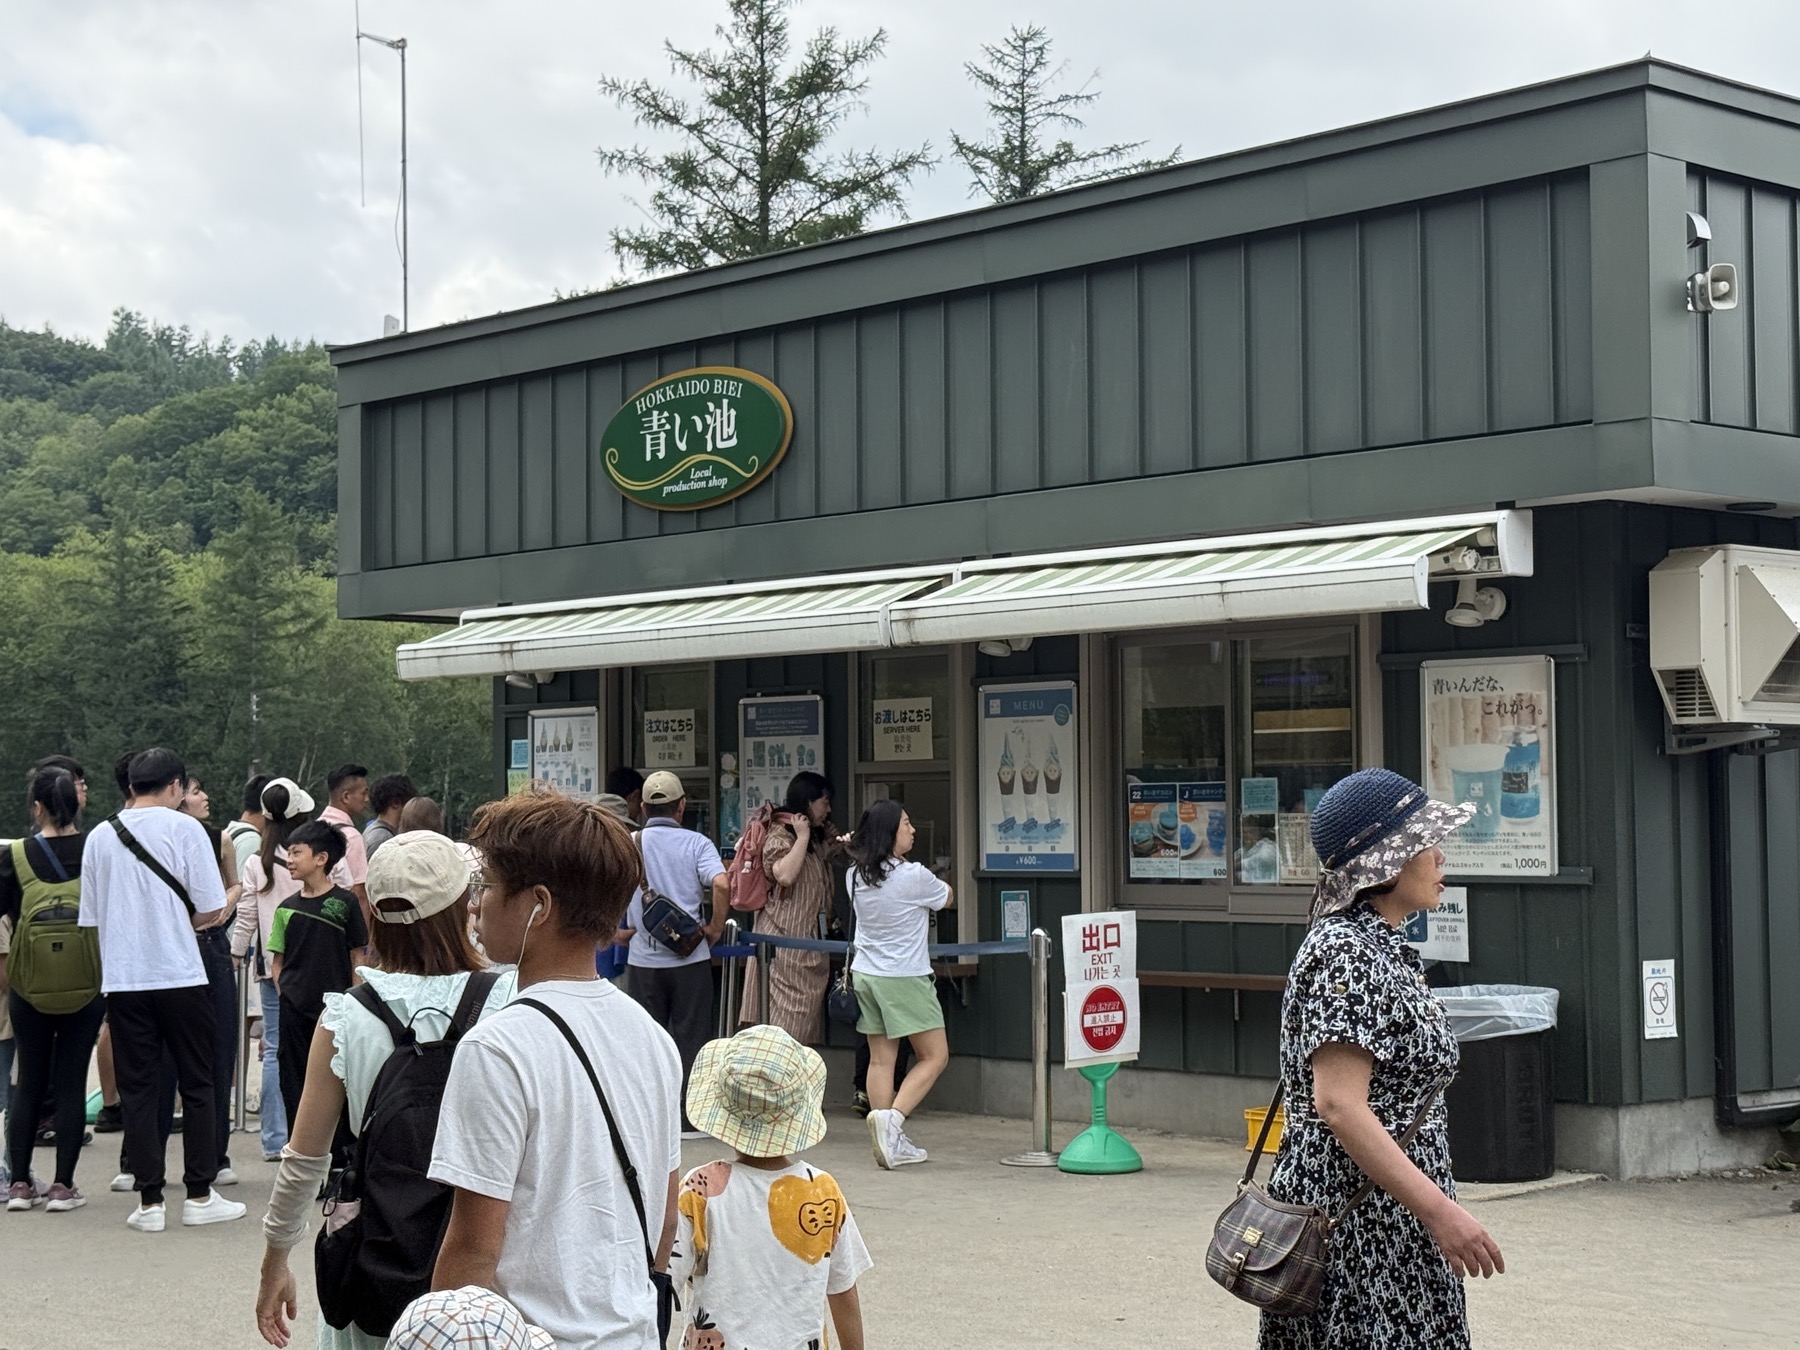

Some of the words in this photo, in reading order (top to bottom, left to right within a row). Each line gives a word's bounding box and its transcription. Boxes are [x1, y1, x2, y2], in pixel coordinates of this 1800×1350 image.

[635, 379, 710, 415] HOKKAIDO
[713, 379, 743, 398] BIEI
[639, 398, 738, 462] 青い池
[690, 465, 712, 480] Local
[662, 478, 707, 497] production
[708, 476, 728, 489] shop
[1433, 676, 1504, 695] 青いんだな、
[1013, 700, 1044, 711] MENU
[1483, 698, 1543, 718] これがっ。
[875, 708, 931, 724] お渡しはこちら
[645, 717, 693, 733] 注文はこちら
[883, 726, 905, 734] SERVER
[906, 725, 921, 733] HERE
[652, 735, 668, 743] ORDER
[673, 734, 687, 742] HERE
[1132, 791, 1142, 799] 22
[1183, 790, 1189, 799] J
[1514, 858, 1547, 870] 1,000円
[1082, 923, 1121, 953] 出口
[1092, 952, 1113, 966] EXIT
[1084, 966, 1109, 981] 나가는
[1112, 964, 1121, 979] 곳
[1085, 1003, 1097, 1013] NO
